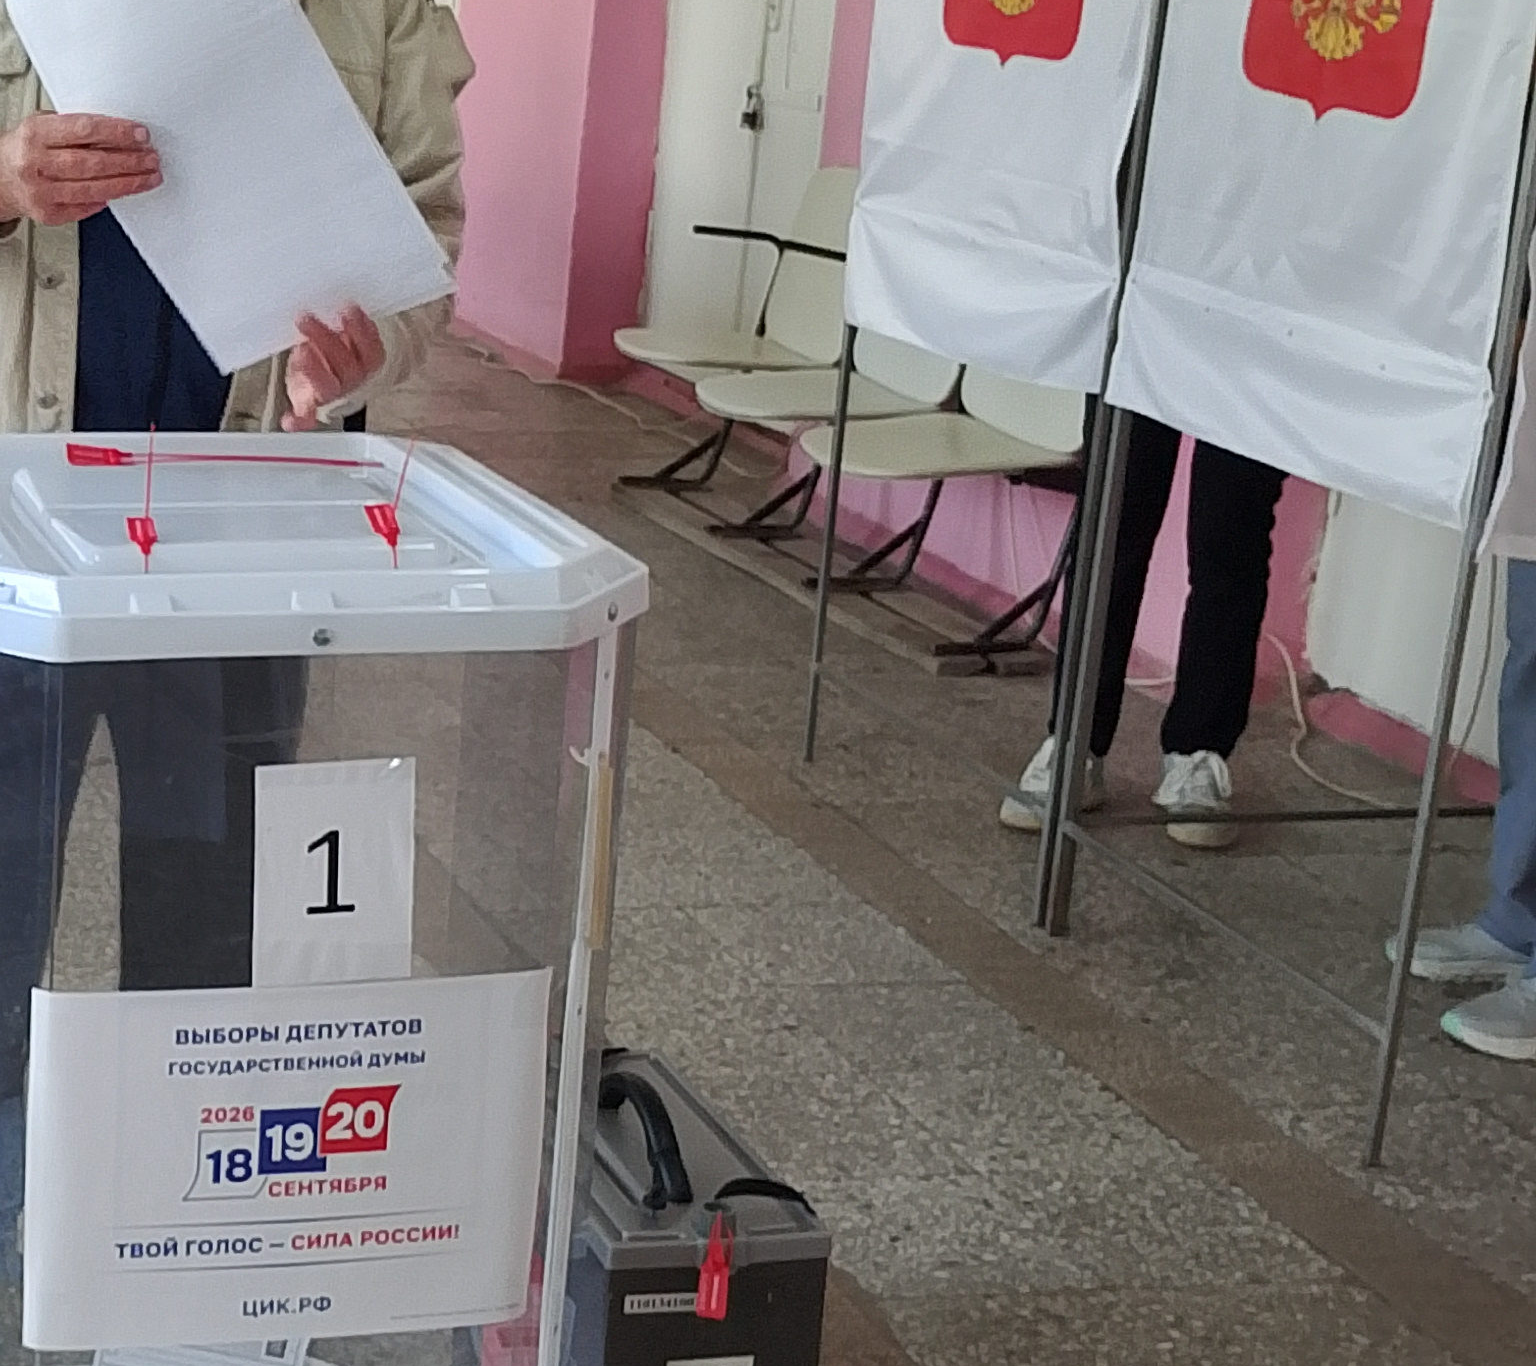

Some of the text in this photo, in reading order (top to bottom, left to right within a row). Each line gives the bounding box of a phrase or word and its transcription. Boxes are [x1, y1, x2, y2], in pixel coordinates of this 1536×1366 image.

[306, 830, 356, 915] 1
[175, 1018, 423, 1046] ВЫБОРЫ ДЕПУТАТОВ
[168, 1050, 426, 1076] ГОСУДАРСТВЕННОЙ ДУМЫ
[200, 1106, 255, 1124] 2026
[325, 1100, 386, 1141] 20
[265, 1123, 314, 1163] 19
[205, 1148, 253, 1184] 18
[268, 1175, 388, 1198] СЕНТЯБРЯ
[115, 1237, 178, 1259] ТВОЙ
[185, 1237, 263, 1256] ГОЛОС
[291, 1233, 352, 1251] СИЛА
[360, 1224, 461, 1247] РОССИИ!
[243, 1296, 332, 1317] ЦИК.РФ
